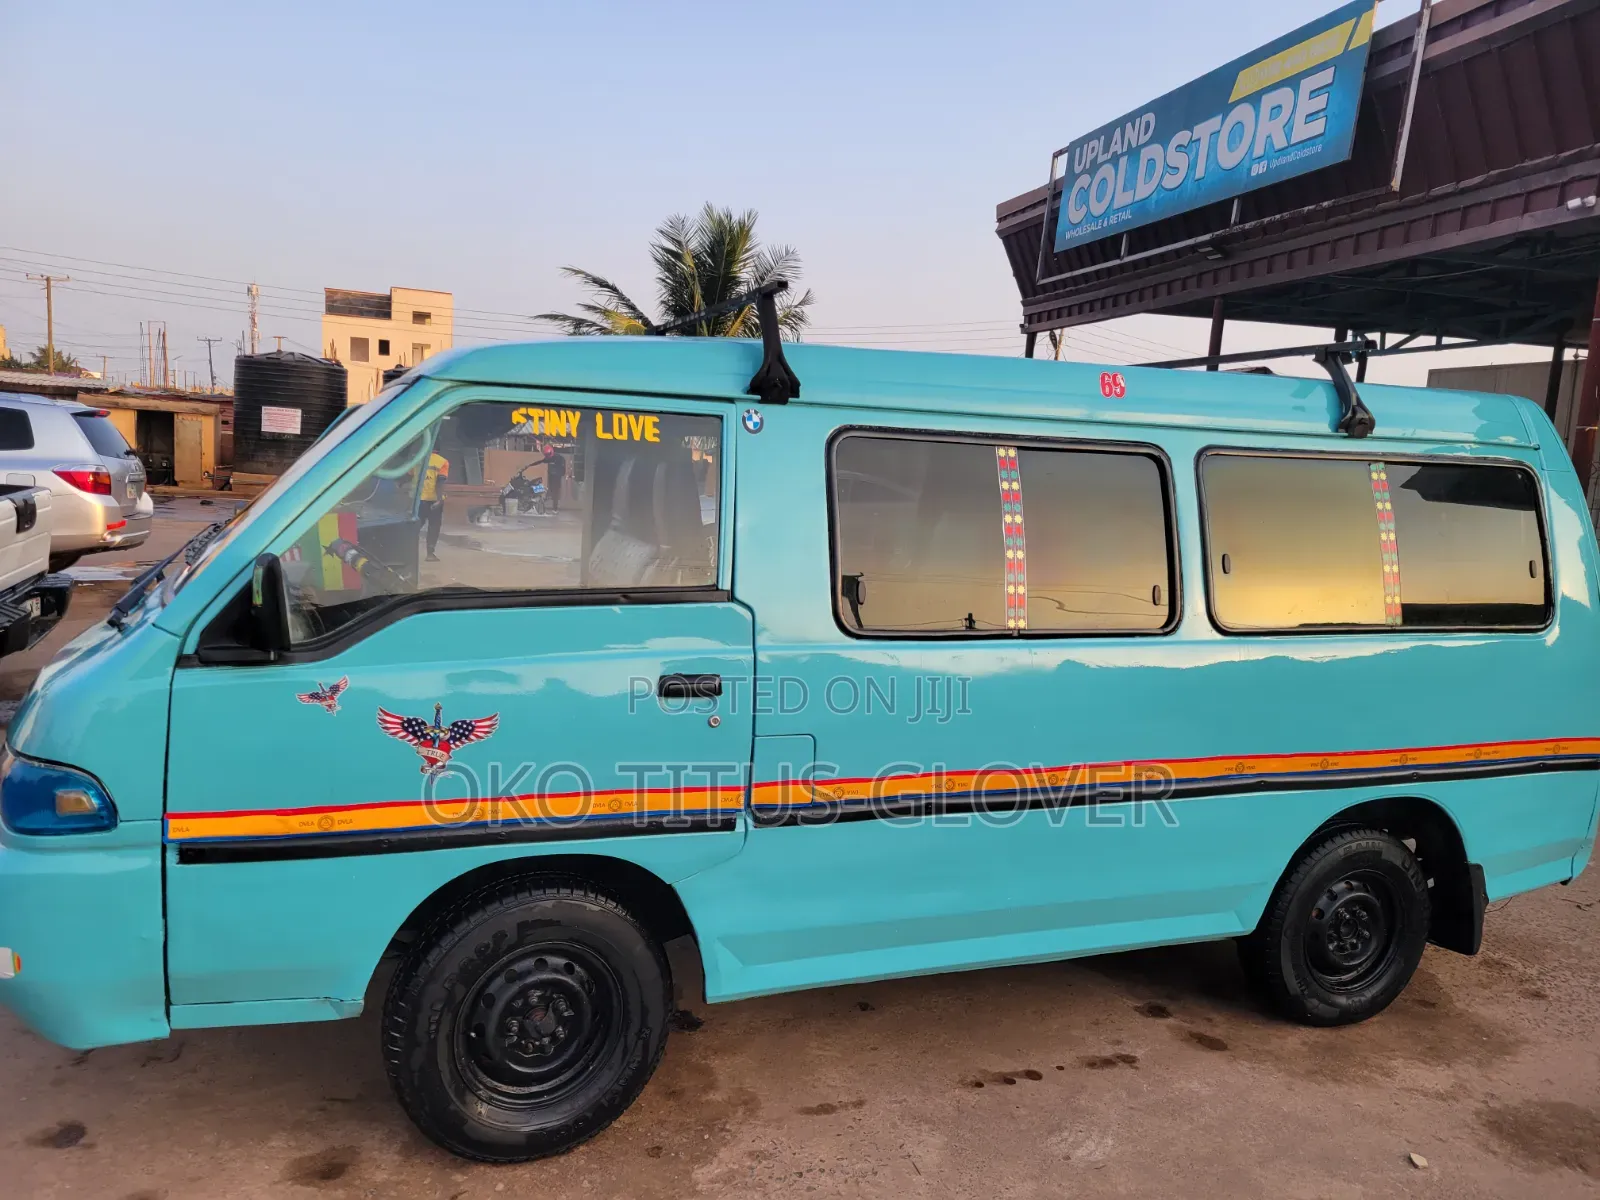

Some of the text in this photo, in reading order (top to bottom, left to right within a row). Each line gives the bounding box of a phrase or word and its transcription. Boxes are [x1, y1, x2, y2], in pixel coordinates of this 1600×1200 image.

[1067, 65, 1337, 226] COLDSTORE
[1073, 111, 1157, 174] UPLAND
[1065, 219, 1102, 241] WHOLESALE
[1109, 208, 1133, 226] RETAIL
[1100, 371, 1126, 399] 69
[596, 412, 660, 443] LOVE
[426, 749, 446, 761] TRUE
[337, 818, 354, 826] DVLA
